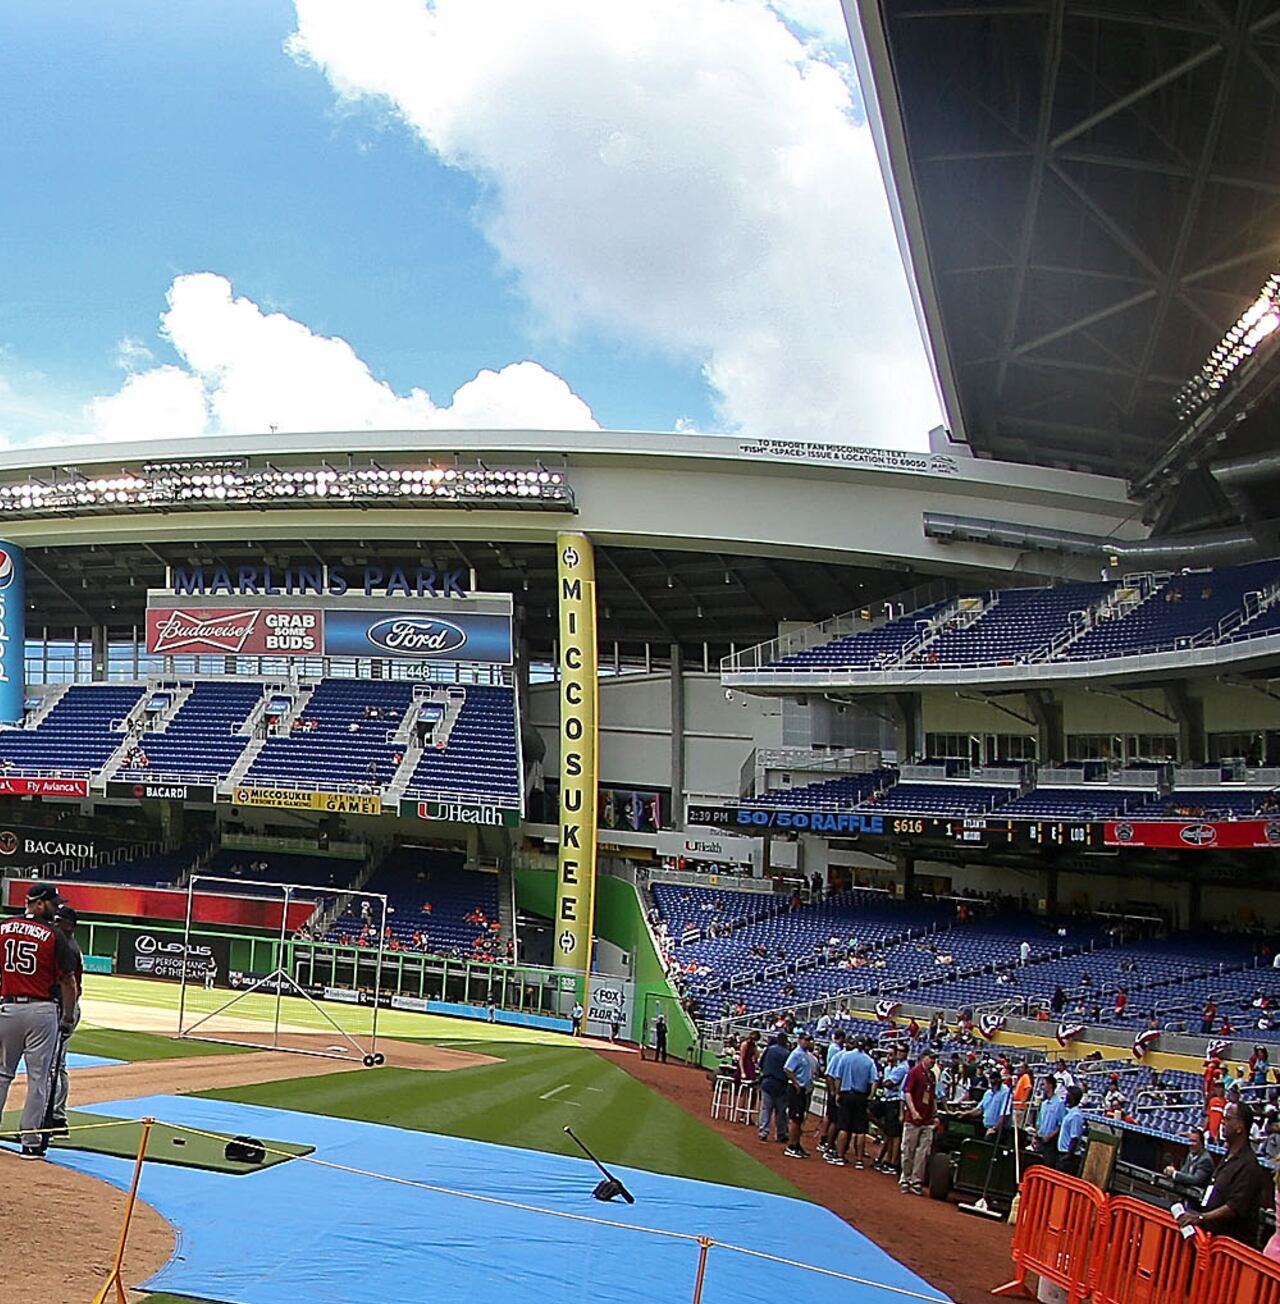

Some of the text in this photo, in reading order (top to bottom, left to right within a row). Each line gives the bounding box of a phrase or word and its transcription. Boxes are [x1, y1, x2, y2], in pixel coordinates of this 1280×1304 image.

[771, 440, 804, 449] REPORT
[807, 442, 826, 450] FAN
[886, 450, 907, 458] TEXT
[808, 451, 832, 459] ISSUE
[841, 454, 884, 463] LOCATION
[174, 565, 468, 598] MARLINS PARK
[265, 614, 316, 628] GRAB
[155, 620, 255, 641] Budweiser
[274, 627, 306, 636] SOME
[386, 622, 447, 650] Ford
[266, 635, 315, 650] BUDS
[407, 666, 430, 678] 448
[561, 578, 585, 921] MICCOSUKEE
[27, 781, 75, 792] Fly Avianca
[146, 785, 188, 799] BACARDÍ
[250, 790, 311, 801] MICCOSUKEE
[326, 801, 375, 813] GAME!
[690, 810, 729, 823] 2:39 PM
[736, 810, 884, 834] 50/50 RAFFLE
[894, 819, 923, 833] $616
[945, 823, 953, 837] 1
[24, 840, 95, 859] BACARDÍ
[0, 922, 52, 942] PIERZYNSKI
[4, 939, 39, 975] 15
[155, 966, 167, 976] OF
[184, 969, 206, 979] GAM
[561, 976, 576, 988] 335
[599, 989, 619, 1002] FOX
